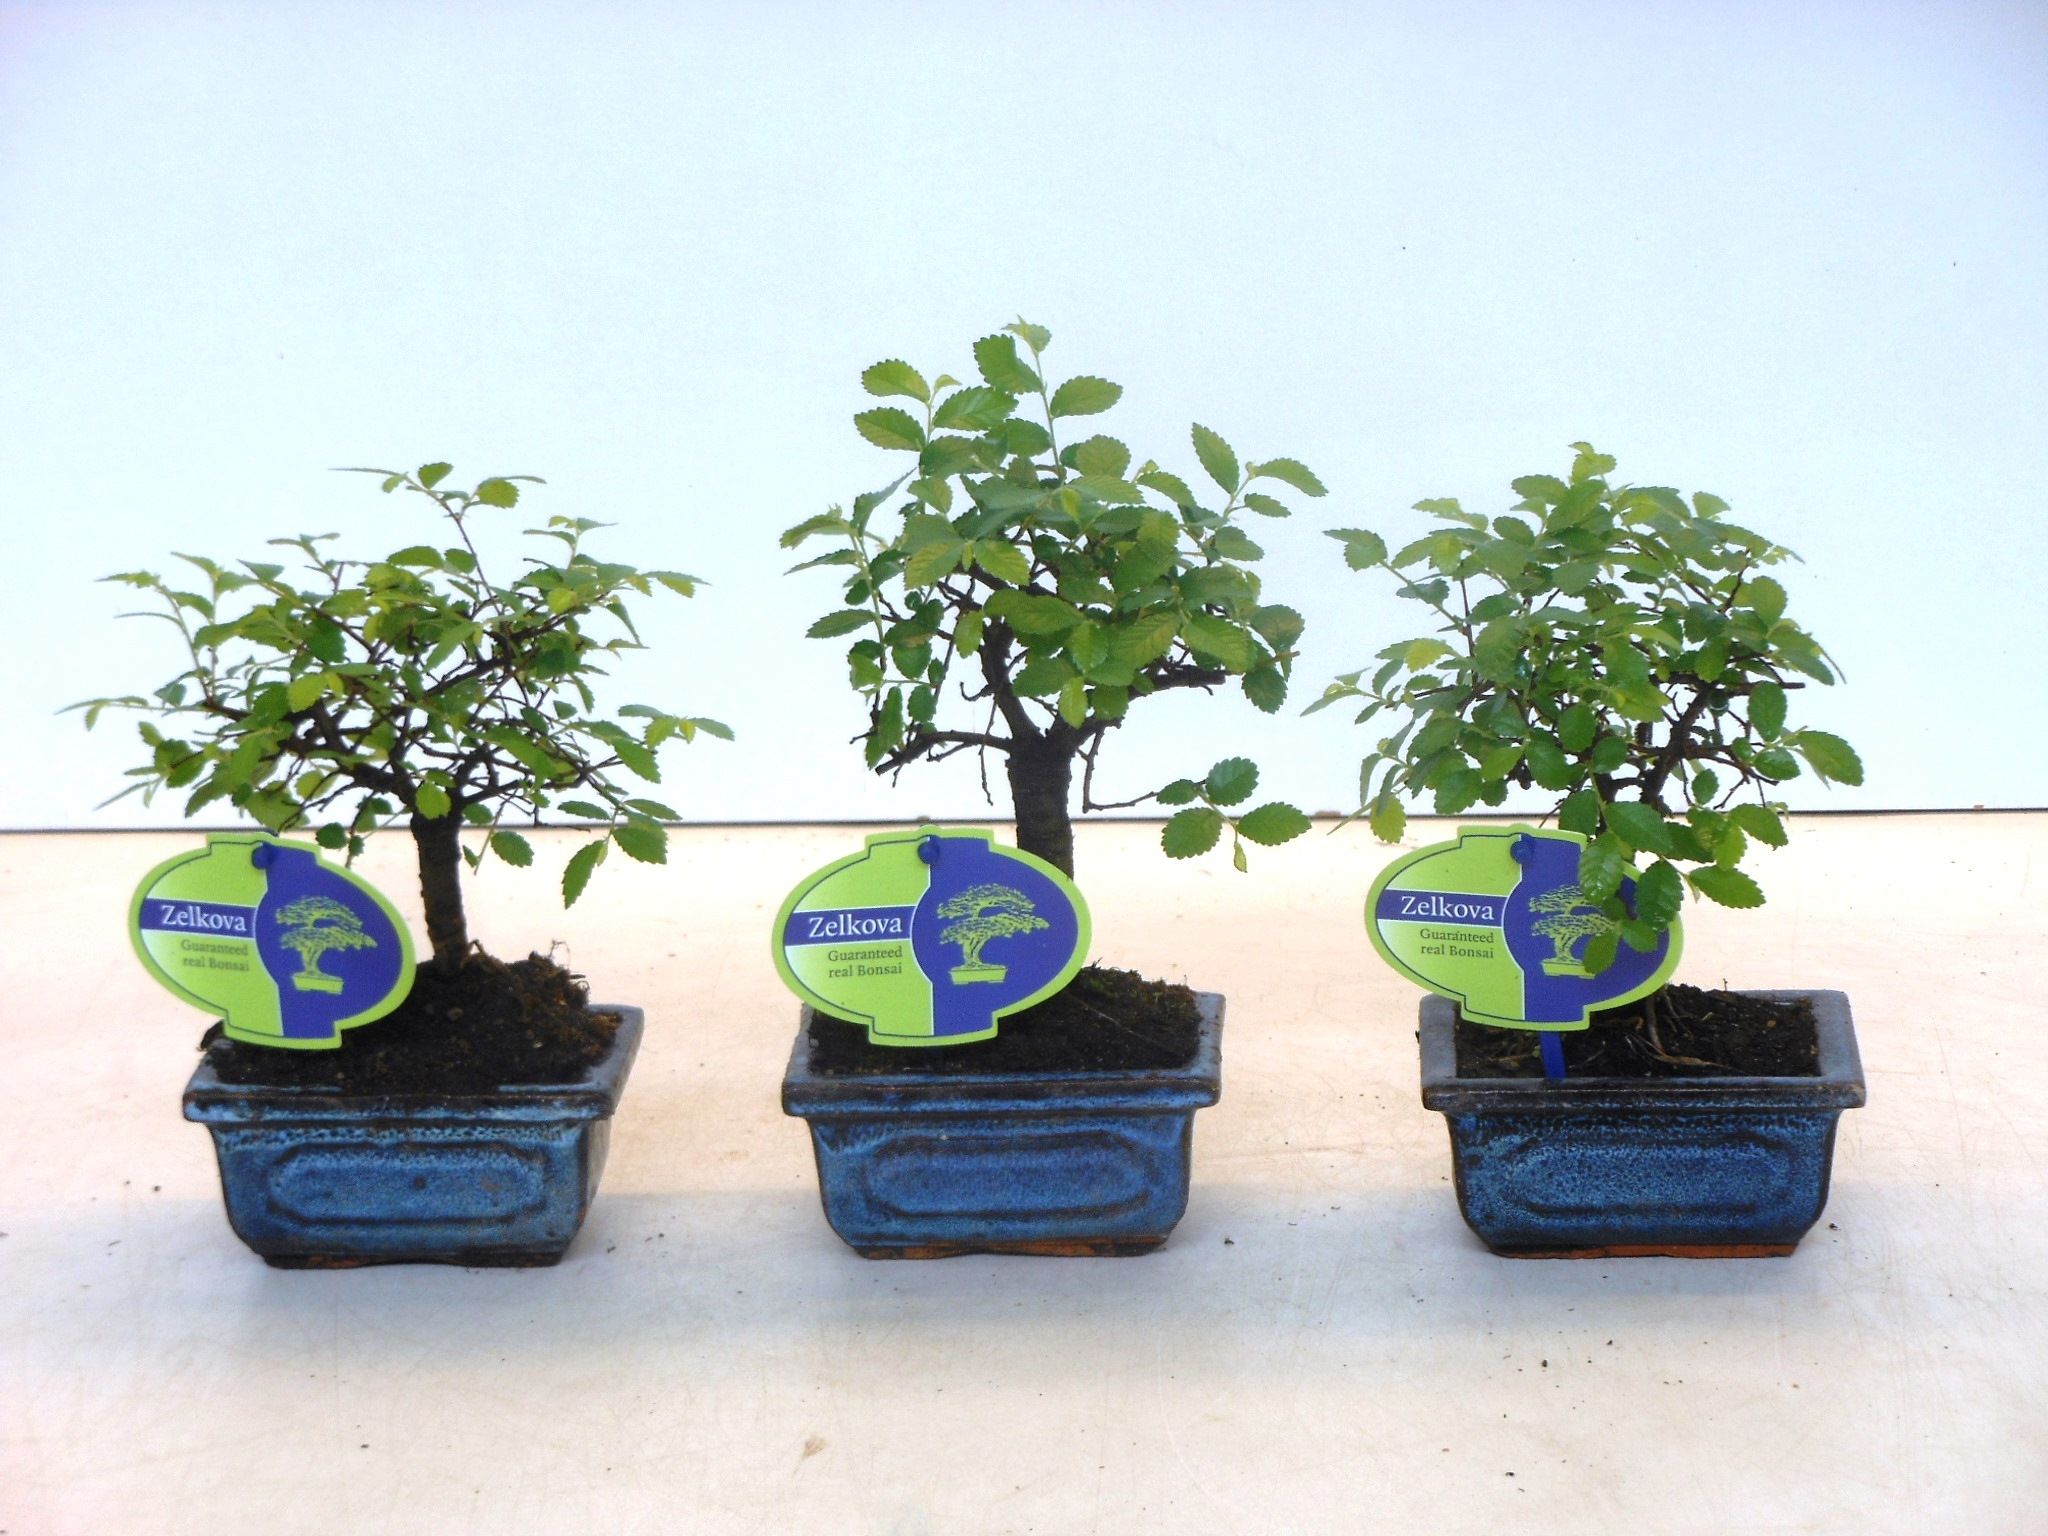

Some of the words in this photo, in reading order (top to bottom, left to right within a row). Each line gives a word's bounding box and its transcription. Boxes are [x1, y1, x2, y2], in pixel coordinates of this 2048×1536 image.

[1400, 895, 1495, 920] Zelkova
[161, 904, 247, 932] Zelkova
[808, 913, 903, 938] Zelkova
[1420, 928, 1494, 943] Guaranteed
[181, 939, 249, 956] Guaranteed
[827, 945, 903, 962] Guaranteed
[1421, 943, 1445, 955] real
[1449, 945, 1494, 959] Bonsai
[182, 956, 206, 968] real
[209, 957, 249, 971] Bonsai
[828, 965, 853, 978] real
[857, 962, 902, 977] Bonsai
